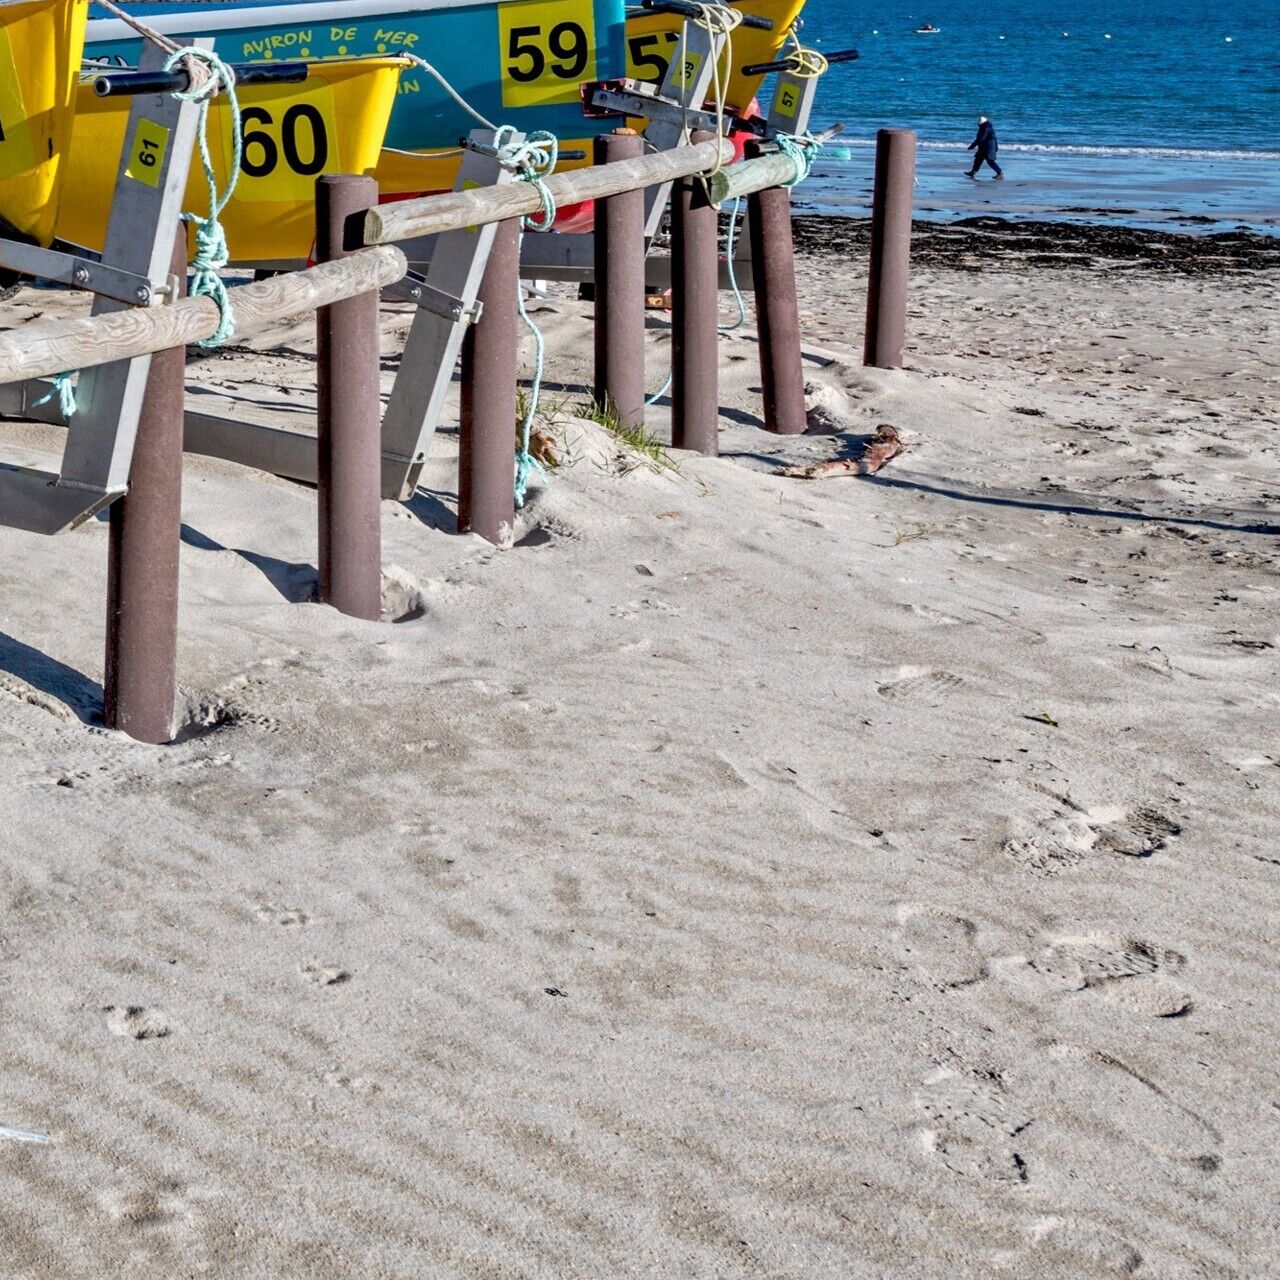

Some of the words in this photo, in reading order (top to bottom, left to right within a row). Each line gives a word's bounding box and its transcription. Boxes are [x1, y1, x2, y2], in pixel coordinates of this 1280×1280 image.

[242, 29, 312, 57] AVIRON
[329, 27, 358, 42] DE
[374, 28, 419, 49] MER
[506, 21, 588, 82] 59
[781, 91, 795, 108] 57
[138, 138, 160, 167] 61
[233, 103, 328, 178] 60
